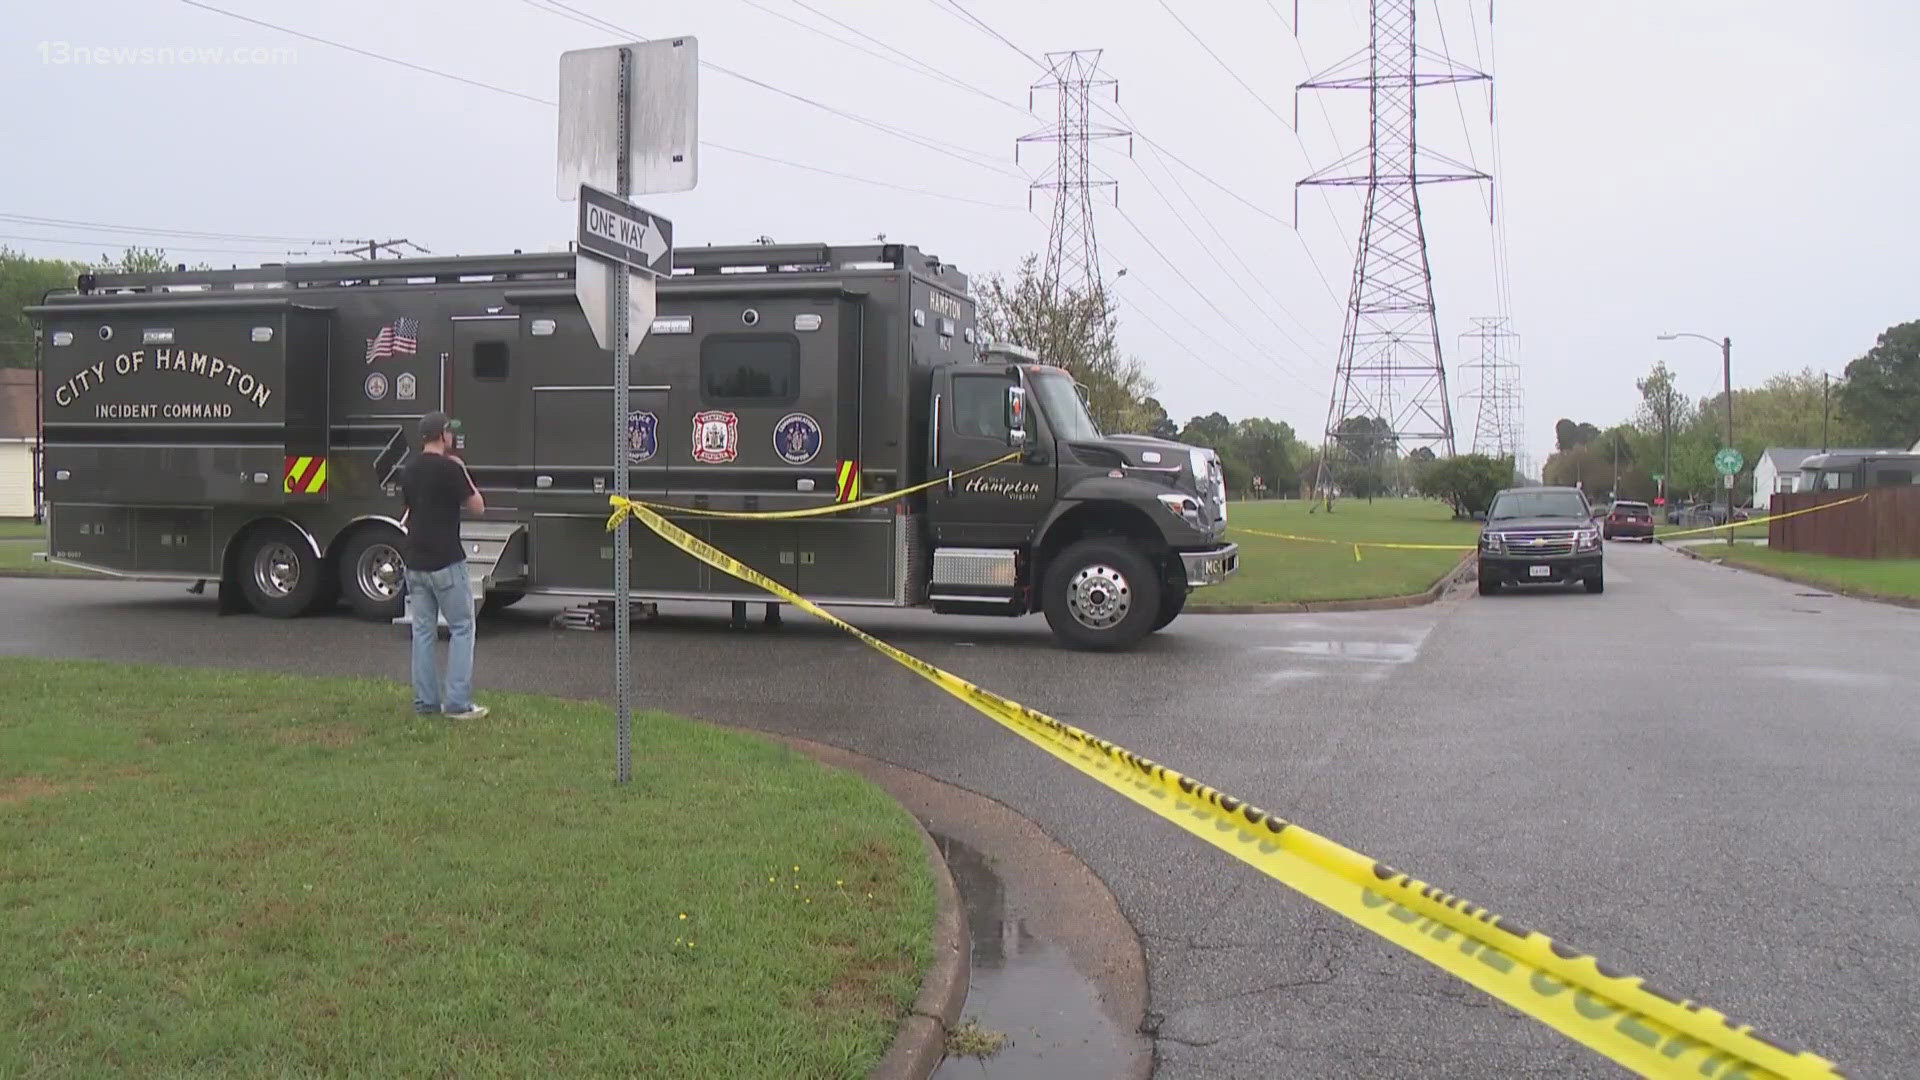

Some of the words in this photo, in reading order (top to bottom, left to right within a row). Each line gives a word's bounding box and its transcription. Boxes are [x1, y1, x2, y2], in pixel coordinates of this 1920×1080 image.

[590, 207, 616, 238] ONE
[620, 218, 646, 250] WAY
[929, 290, 961, 321] HAMPTON
[55, 361, 105, 406] CITY
[115, 351, 145, 375] OF
[156, 349, 272, 408] HAMPTON
[95, 404, 158, 418] INCIDENT
[163, 404, 232, 418] COMMAND
[628, 414, 651, 424] OLICE
[965, 476, 1039, 496] Hampton
